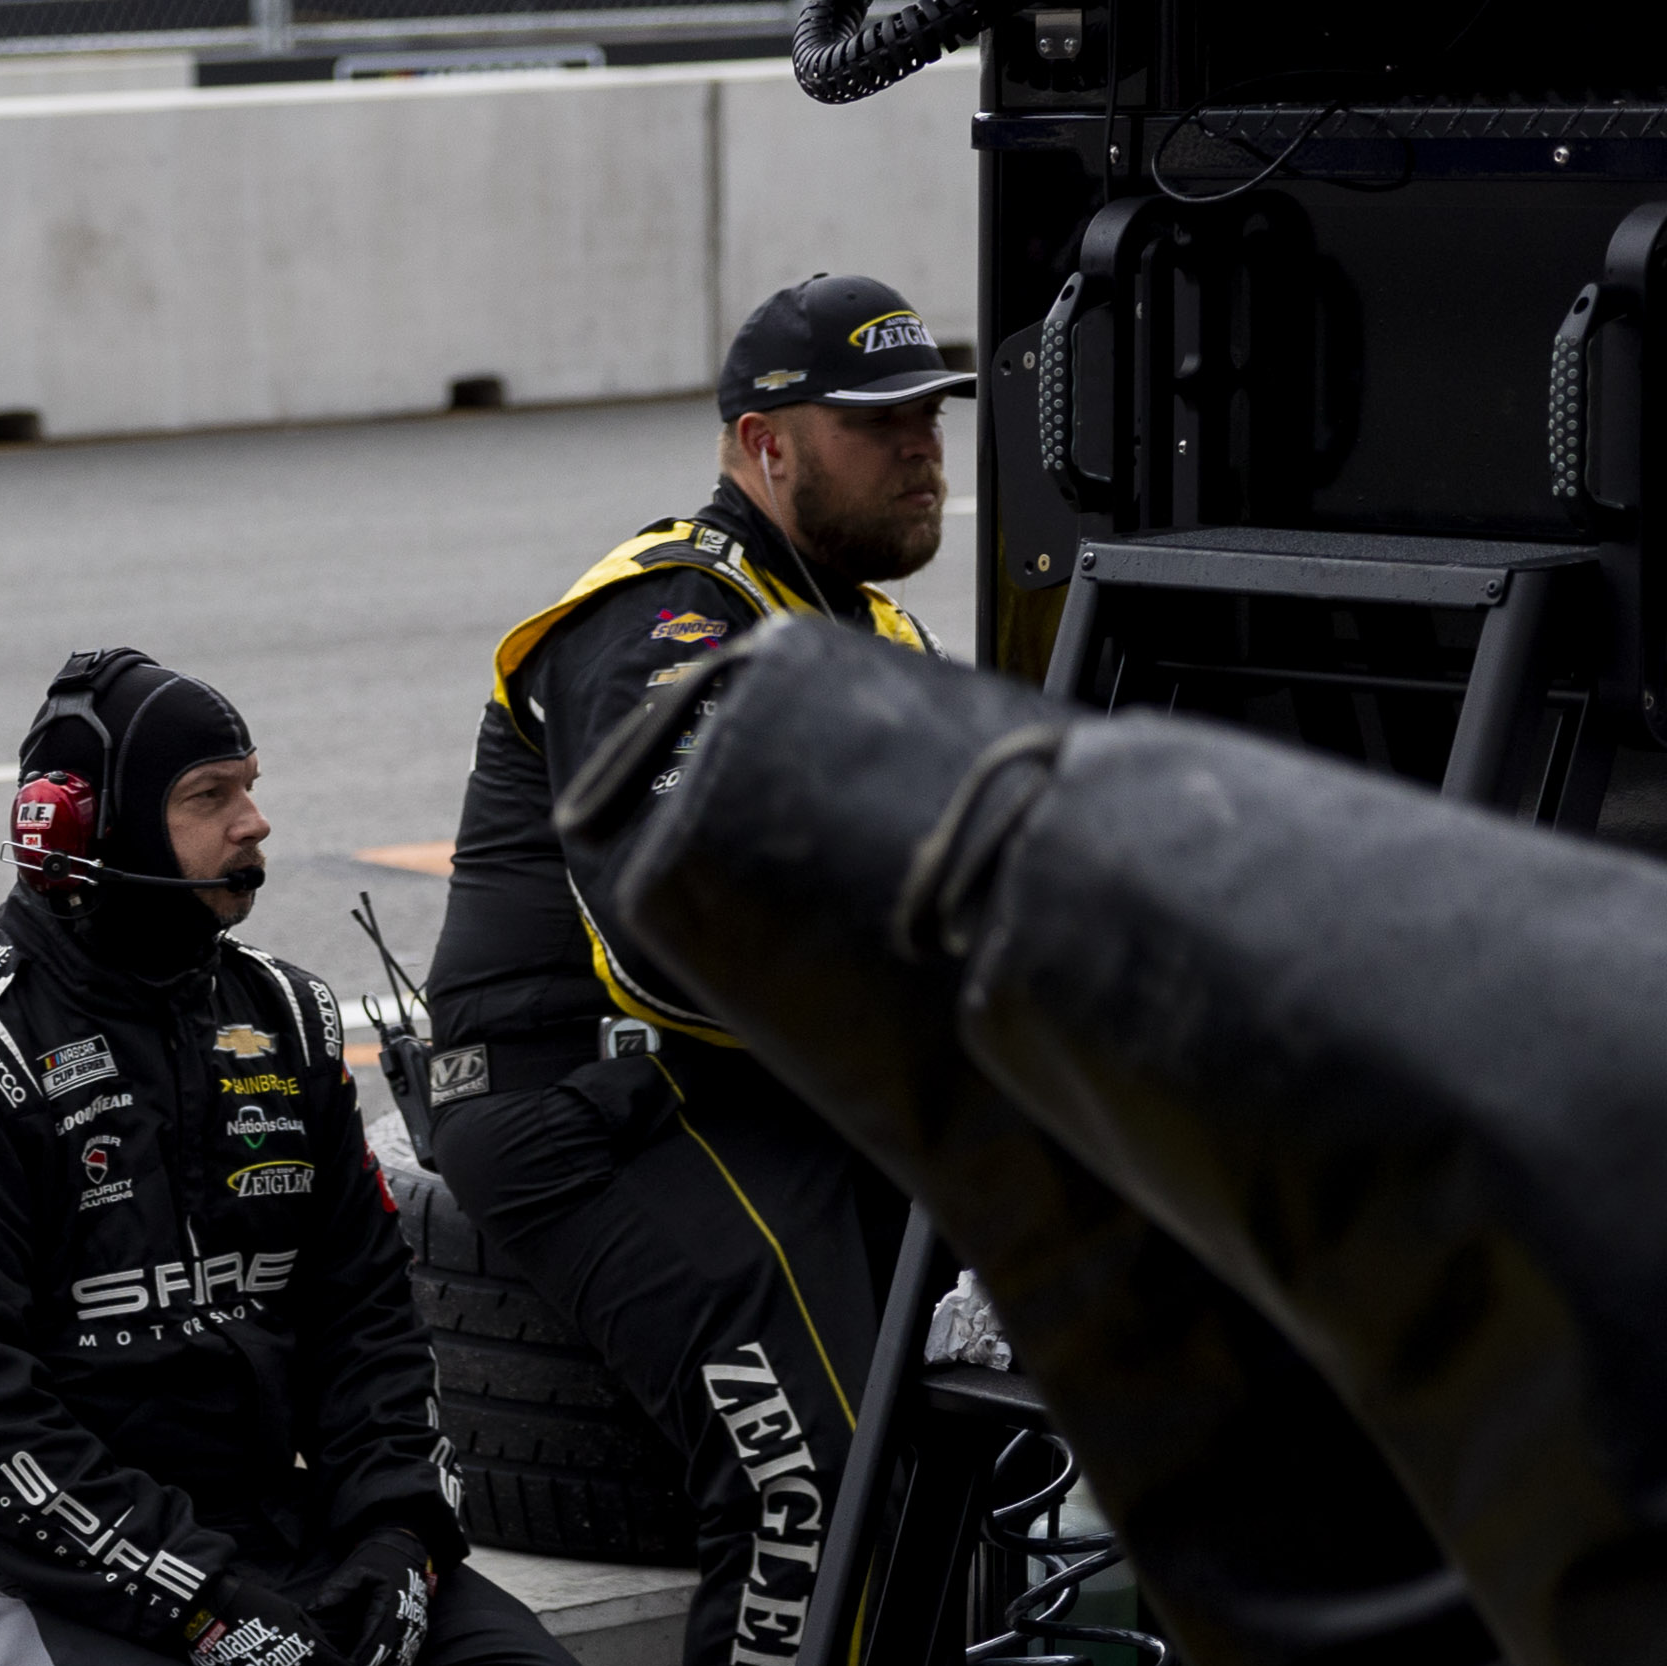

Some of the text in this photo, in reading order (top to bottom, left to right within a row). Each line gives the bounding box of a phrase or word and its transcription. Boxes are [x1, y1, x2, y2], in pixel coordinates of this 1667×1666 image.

[655, 621, 726, 639] SUNOCO
[27, 837, 39, 846] 3M
[618, 1035, 643, 1049] 77
[59, 1042, 96, 1062] NASCAR
[53, 1058, 106, 1086] CUP SERIES
[237, 1169, 314, 1198] ZEIGLER
